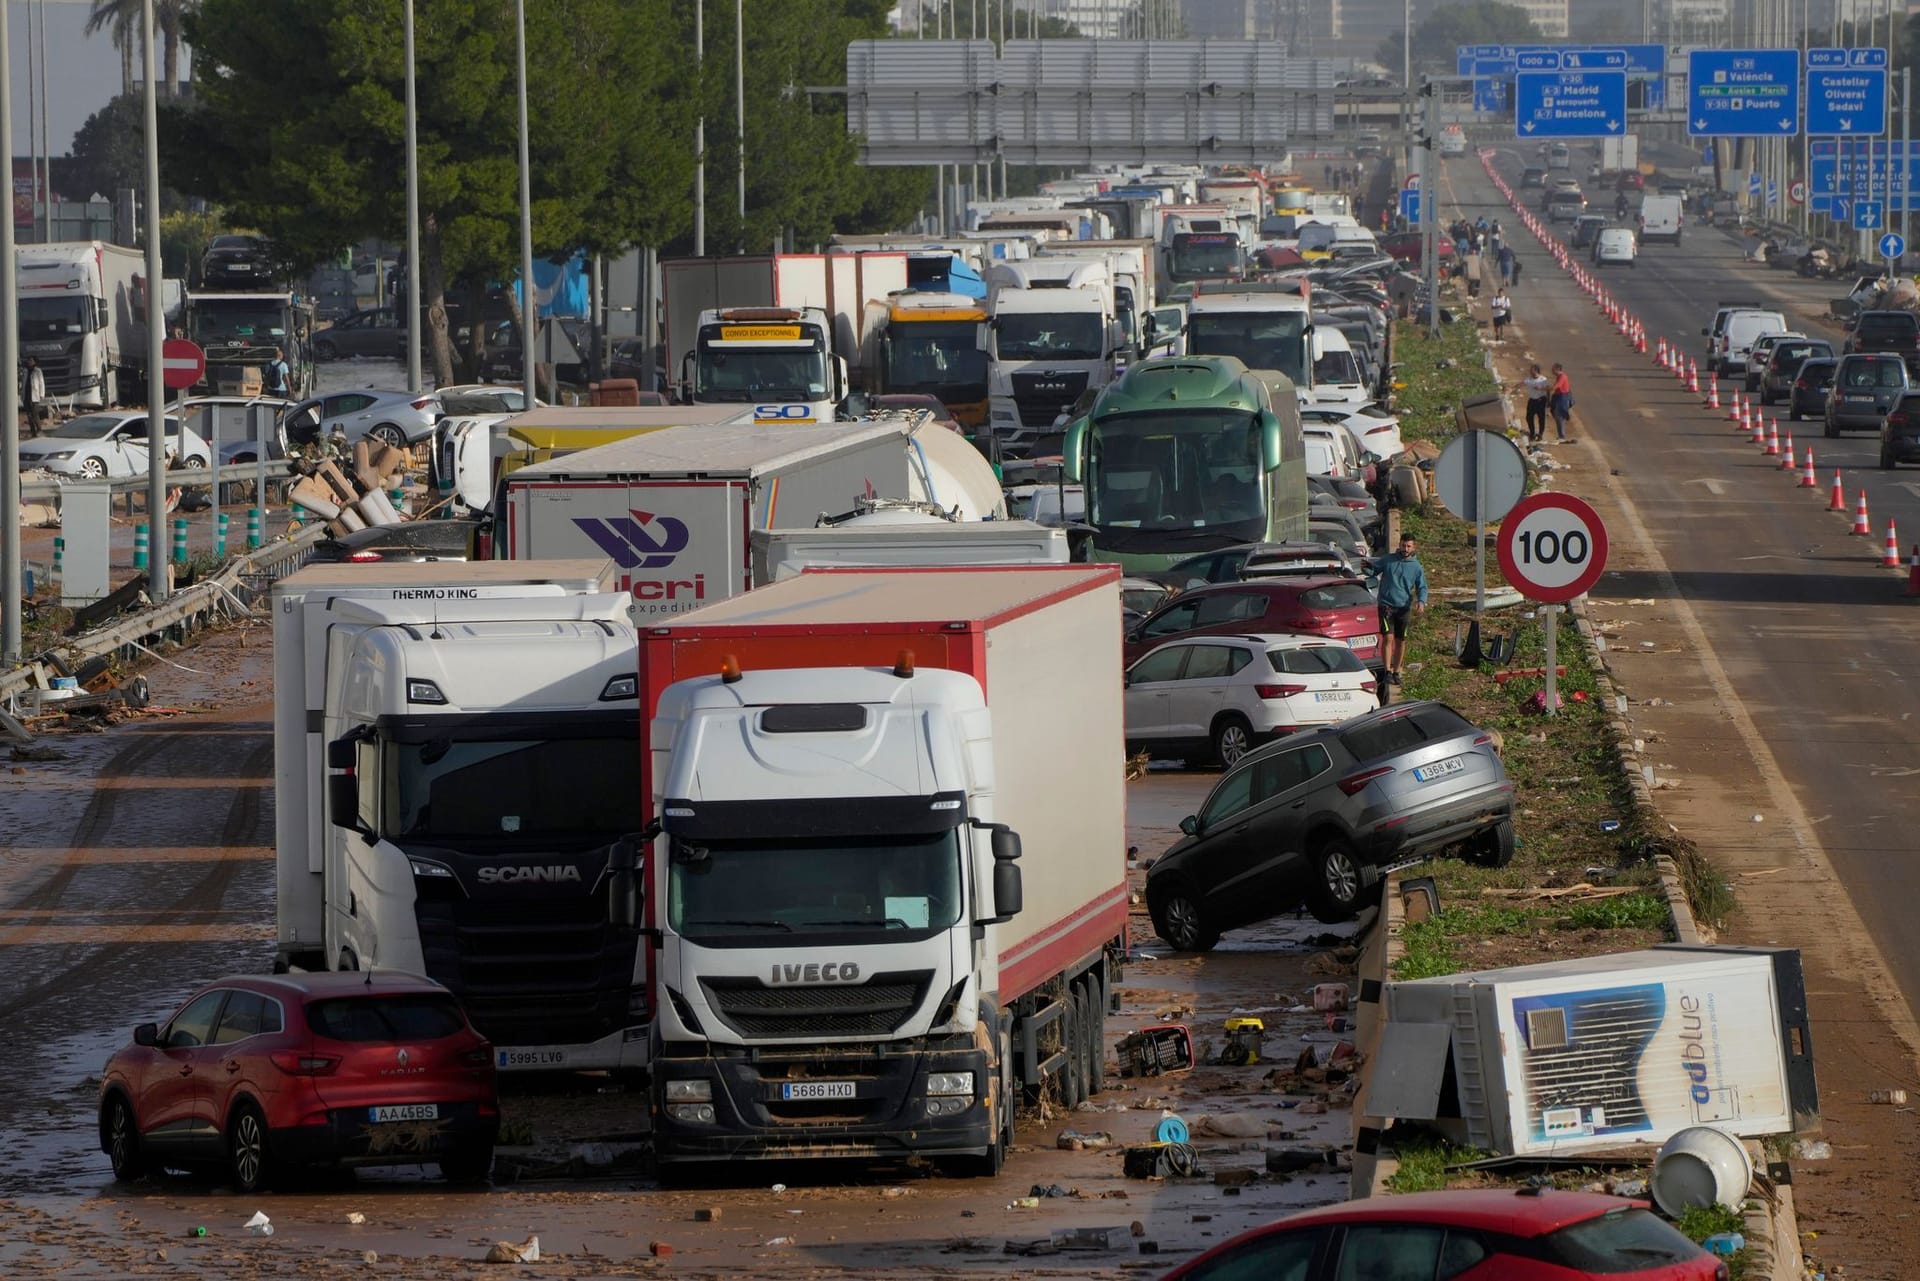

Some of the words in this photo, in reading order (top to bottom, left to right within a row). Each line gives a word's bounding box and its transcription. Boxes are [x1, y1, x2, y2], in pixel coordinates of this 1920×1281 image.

[1522, 57, 1543, 65] 1000
[1813, 54, 1829, 62] 500
[1561, 75, 1581, 83] V-30
[1822, 77, 1870, 86] Castellar
[1543, 87, 1559, 95] A-3
[1563, 86, 1599, 95] Madrid
[1556, 98, 1599, 107] aeropuerto
[1746, 100, 1780, 108] Puerto
[1555, 109, 1606, 118] Barcelona
[725, 330, 749, 338] CONVOI
[749, 329, 797, 338] EXCEPTIONNEL
[754, 404, 811, 419] SO
[1519, 530, 1588, 565] 100
[615, 574, 704, 599] lcri
[393, 590, 445, 599] THERMO
[448, 589, 478, 598] KING
[1422, 764, 1445, 778] 1368
[1445, 758, 1462, 770] MCV
[478, 865, 583, 883] SCANIA
[772, 962, 860, 982] IVECO
[1679, 995, 1711, 1105] adblue
[510, 1052, 538, 1064] 5995
[541, 1051, 562, 1063] LVG
[792, 1085, 825, 1097] 5686
[828, 1084, 852, 1097] HXD
